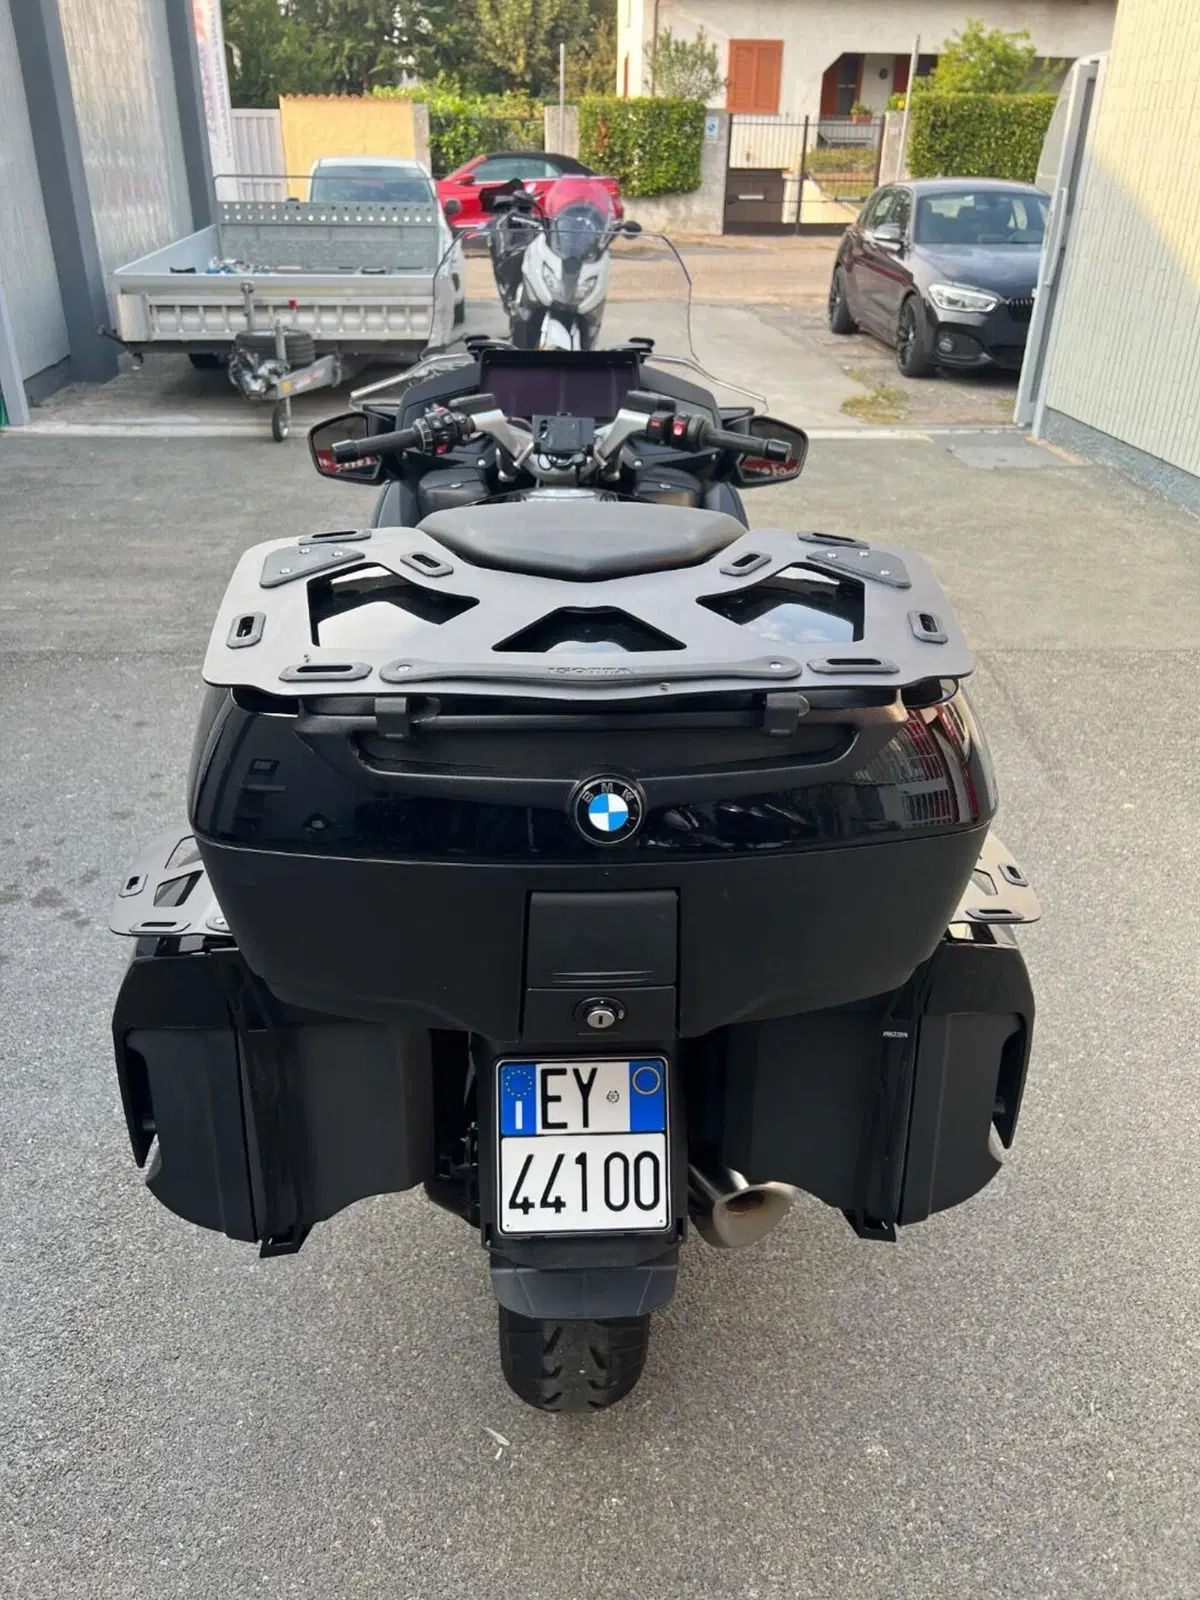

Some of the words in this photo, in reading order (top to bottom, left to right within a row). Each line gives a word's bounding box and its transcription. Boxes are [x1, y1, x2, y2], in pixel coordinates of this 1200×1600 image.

[581, 782, 635, 804] BMW
[515, 1100, 523, 1130] I
[540, 1067, 599, 1130] EY
[508, 1150, 661, 1215] 44100
